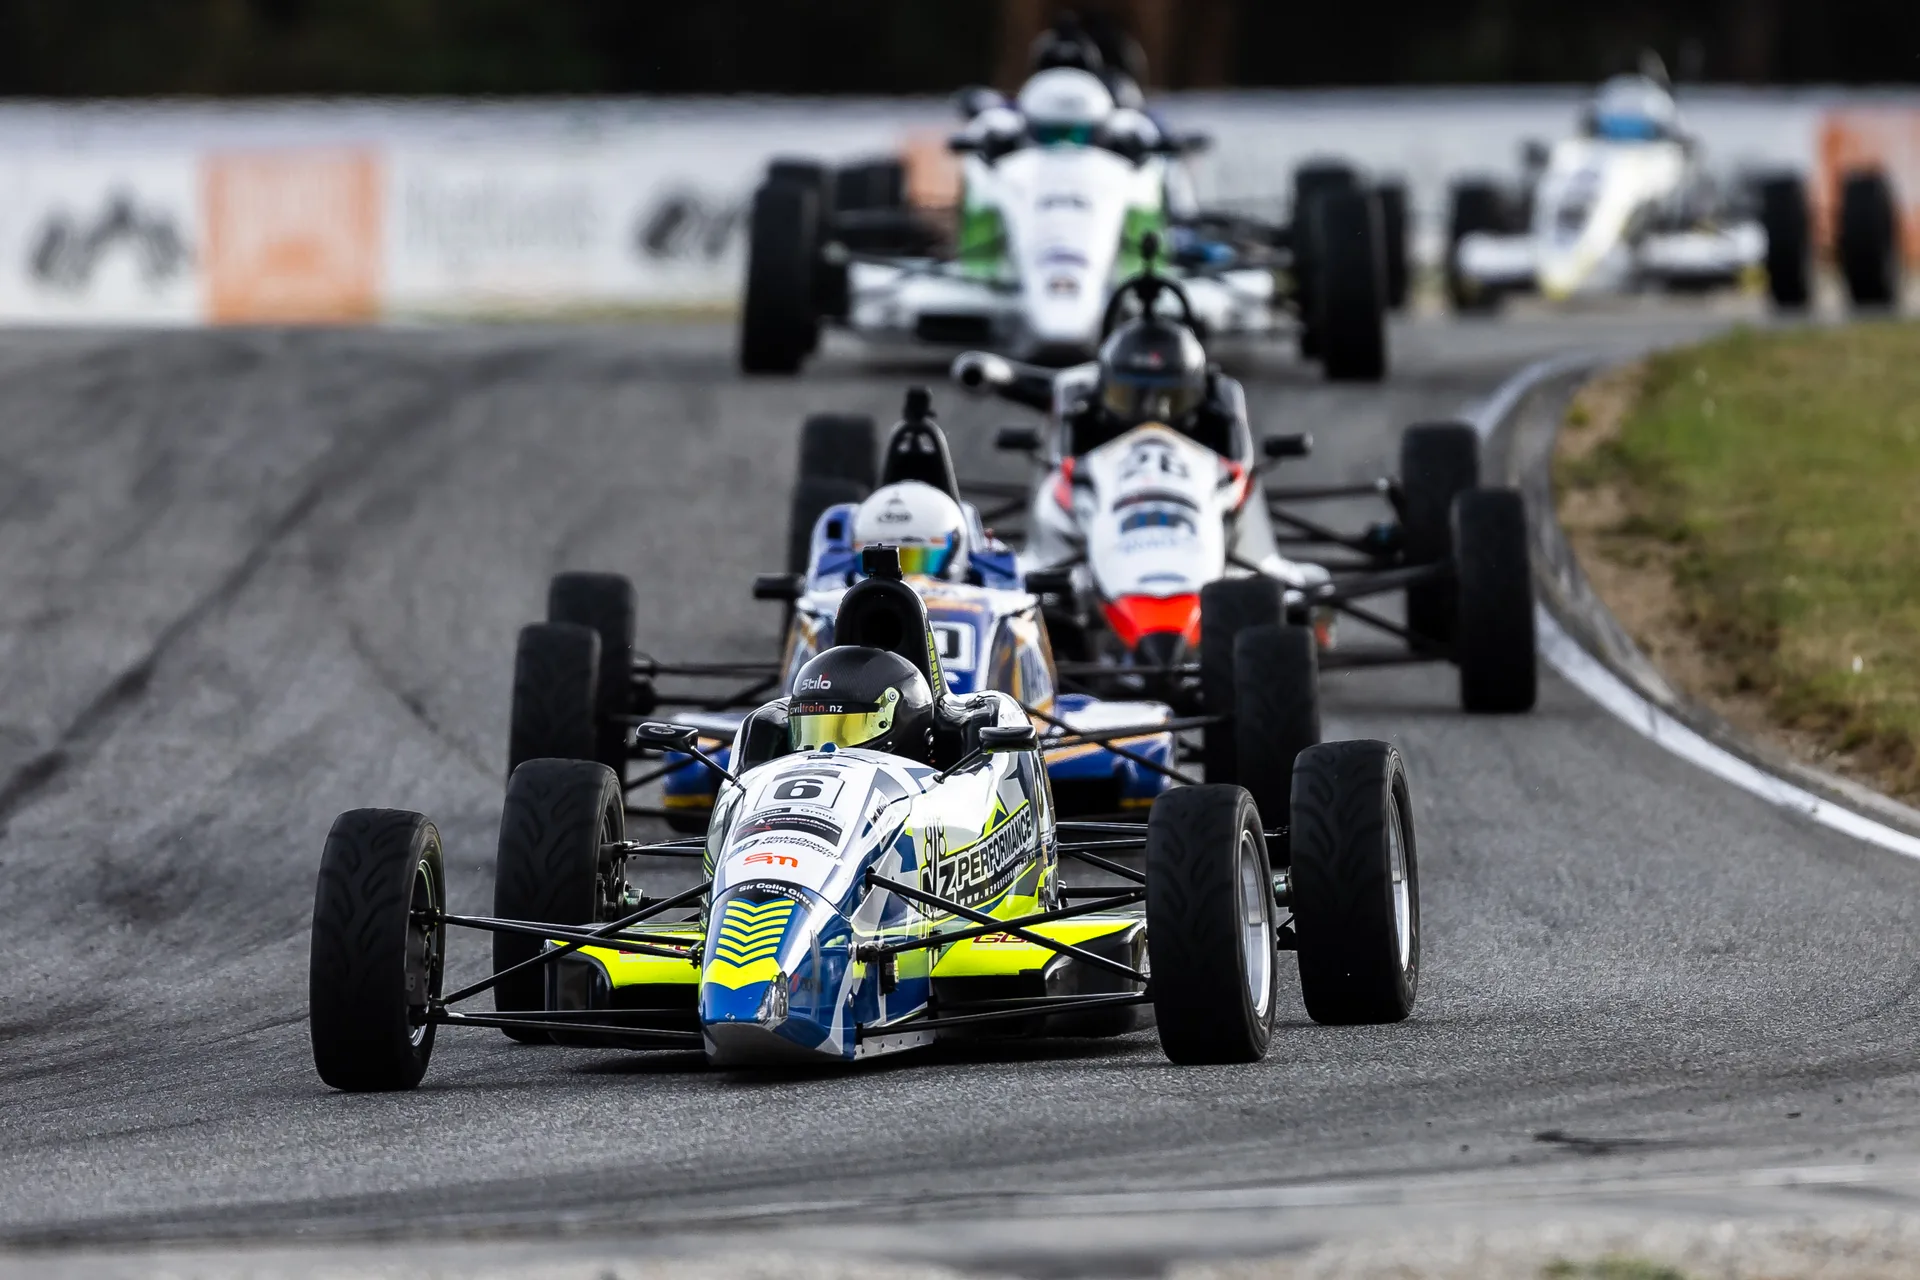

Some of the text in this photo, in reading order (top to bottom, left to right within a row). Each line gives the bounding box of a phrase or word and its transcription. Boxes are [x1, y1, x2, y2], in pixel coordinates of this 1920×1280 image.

[800, 673, 832, 691] Stilo
[789, 702, 843, 715] civiltrain.nz
[773, 778, 824, 800] 6
[800, 808, 836, 821] Group
[738, 884, 755, 893] Sir
[755, 882, 787, 893] Colin
